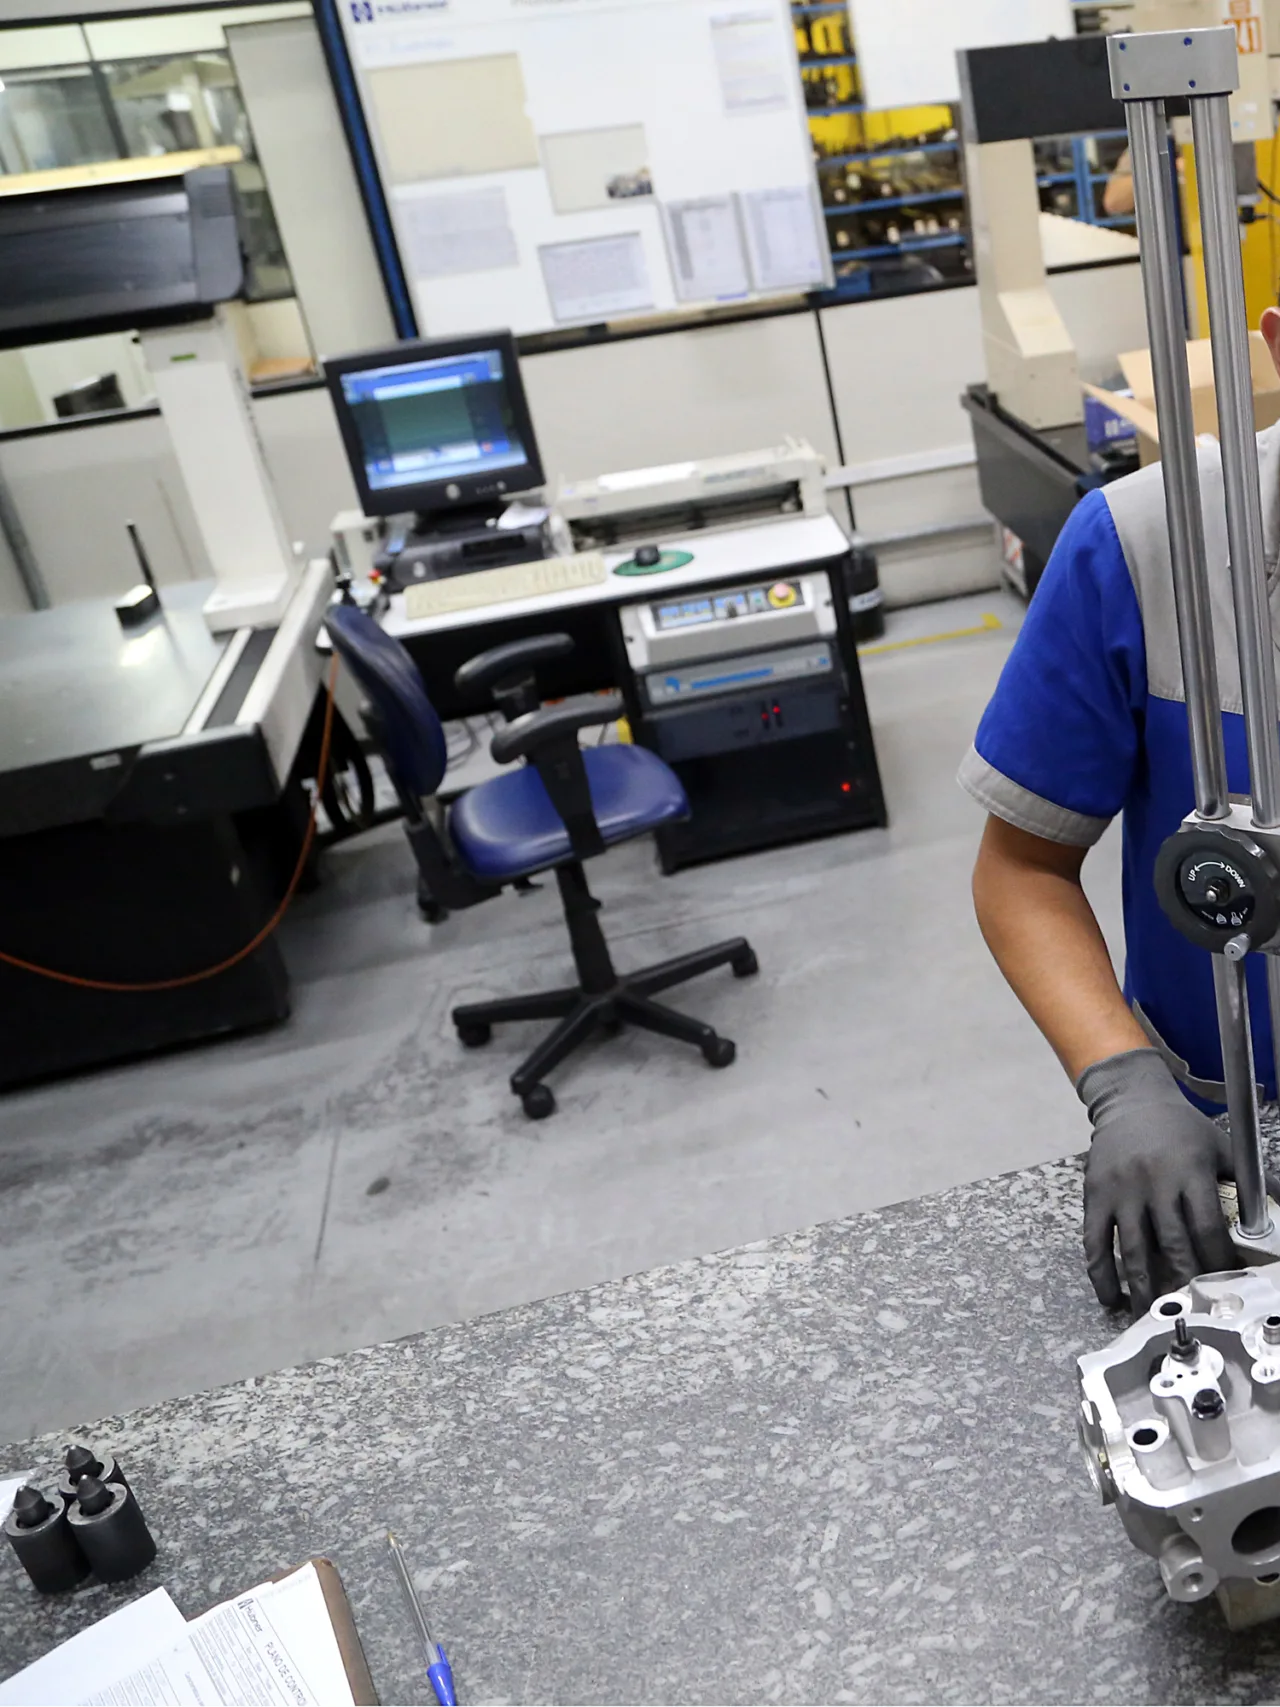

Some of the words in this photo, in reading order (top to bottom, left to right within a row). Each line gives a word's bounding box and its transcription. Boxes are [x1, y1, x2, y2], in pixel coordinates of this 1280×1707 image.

[1188, 869, 1197, 881] UP
[1225, 865, 1246, 887] DOWN
[265, 1642, 283, 1667] PLANO
[278, 1664, 290, 1678] DE
